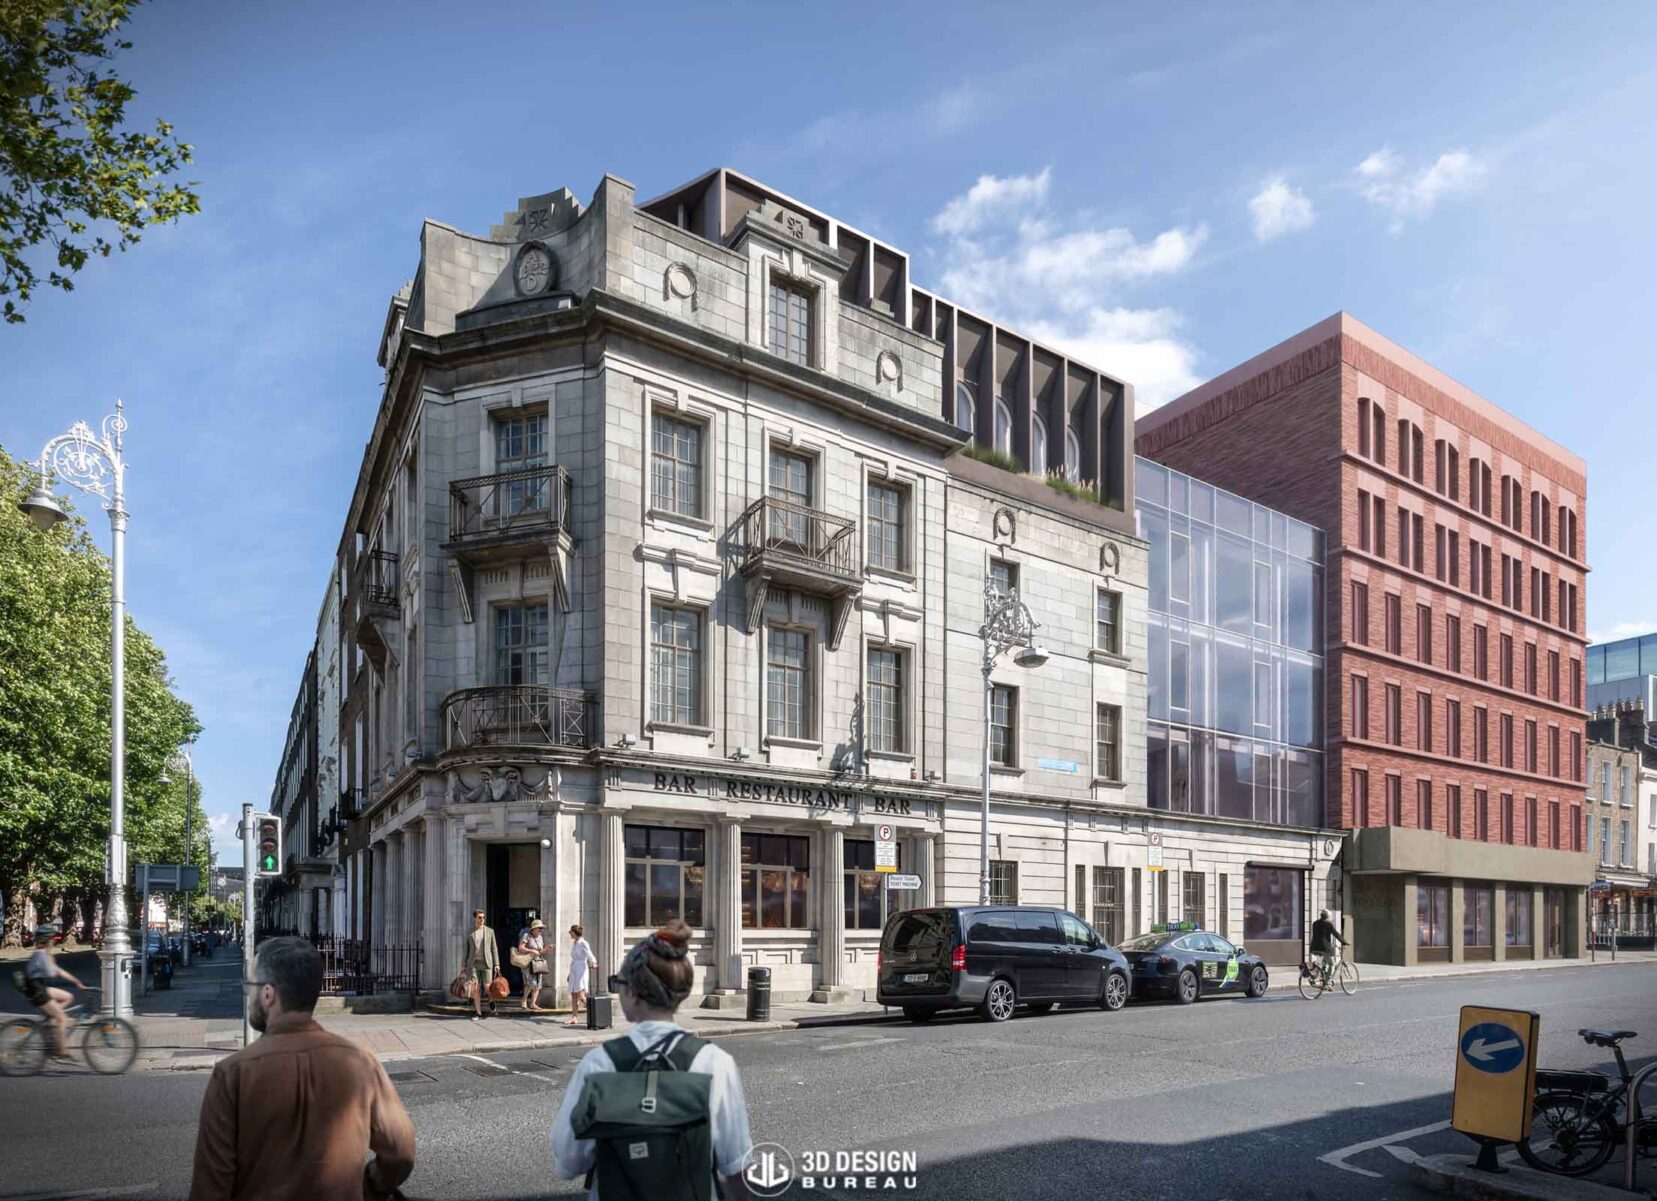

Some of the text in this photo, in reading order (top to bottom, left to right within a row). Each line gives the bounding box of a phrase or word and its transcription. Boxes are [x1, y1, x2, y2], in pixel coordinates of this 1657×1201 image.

[654, 773, 697, 794] BAR
[726, 780, 852, 809] RESTAURANT
[874, 797, 912, 815] BAR
